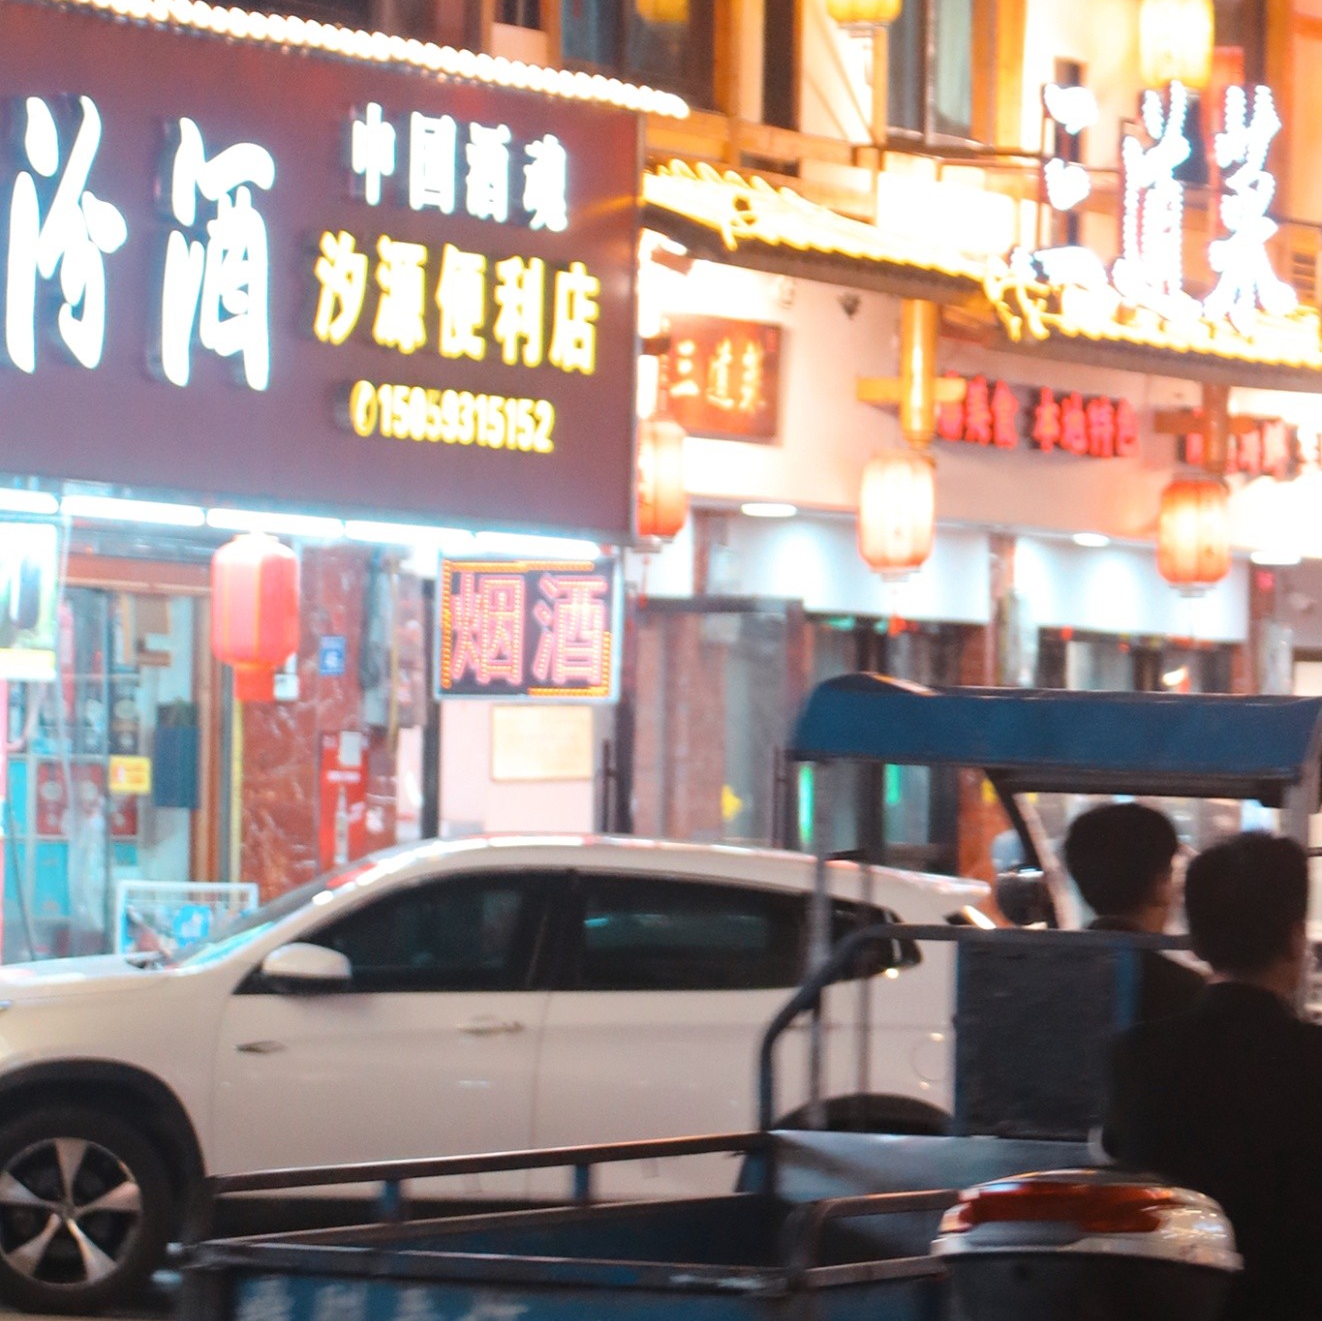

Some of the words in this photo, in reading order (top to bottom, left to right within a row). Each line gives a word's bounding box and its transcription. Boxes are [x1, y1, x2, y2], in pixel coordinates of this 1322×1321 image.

[351, 101, 569, 233] 中国酒魂
[4, 94, 275, 391] 汾酒
[451, 570, 609, 686] 烟酒
